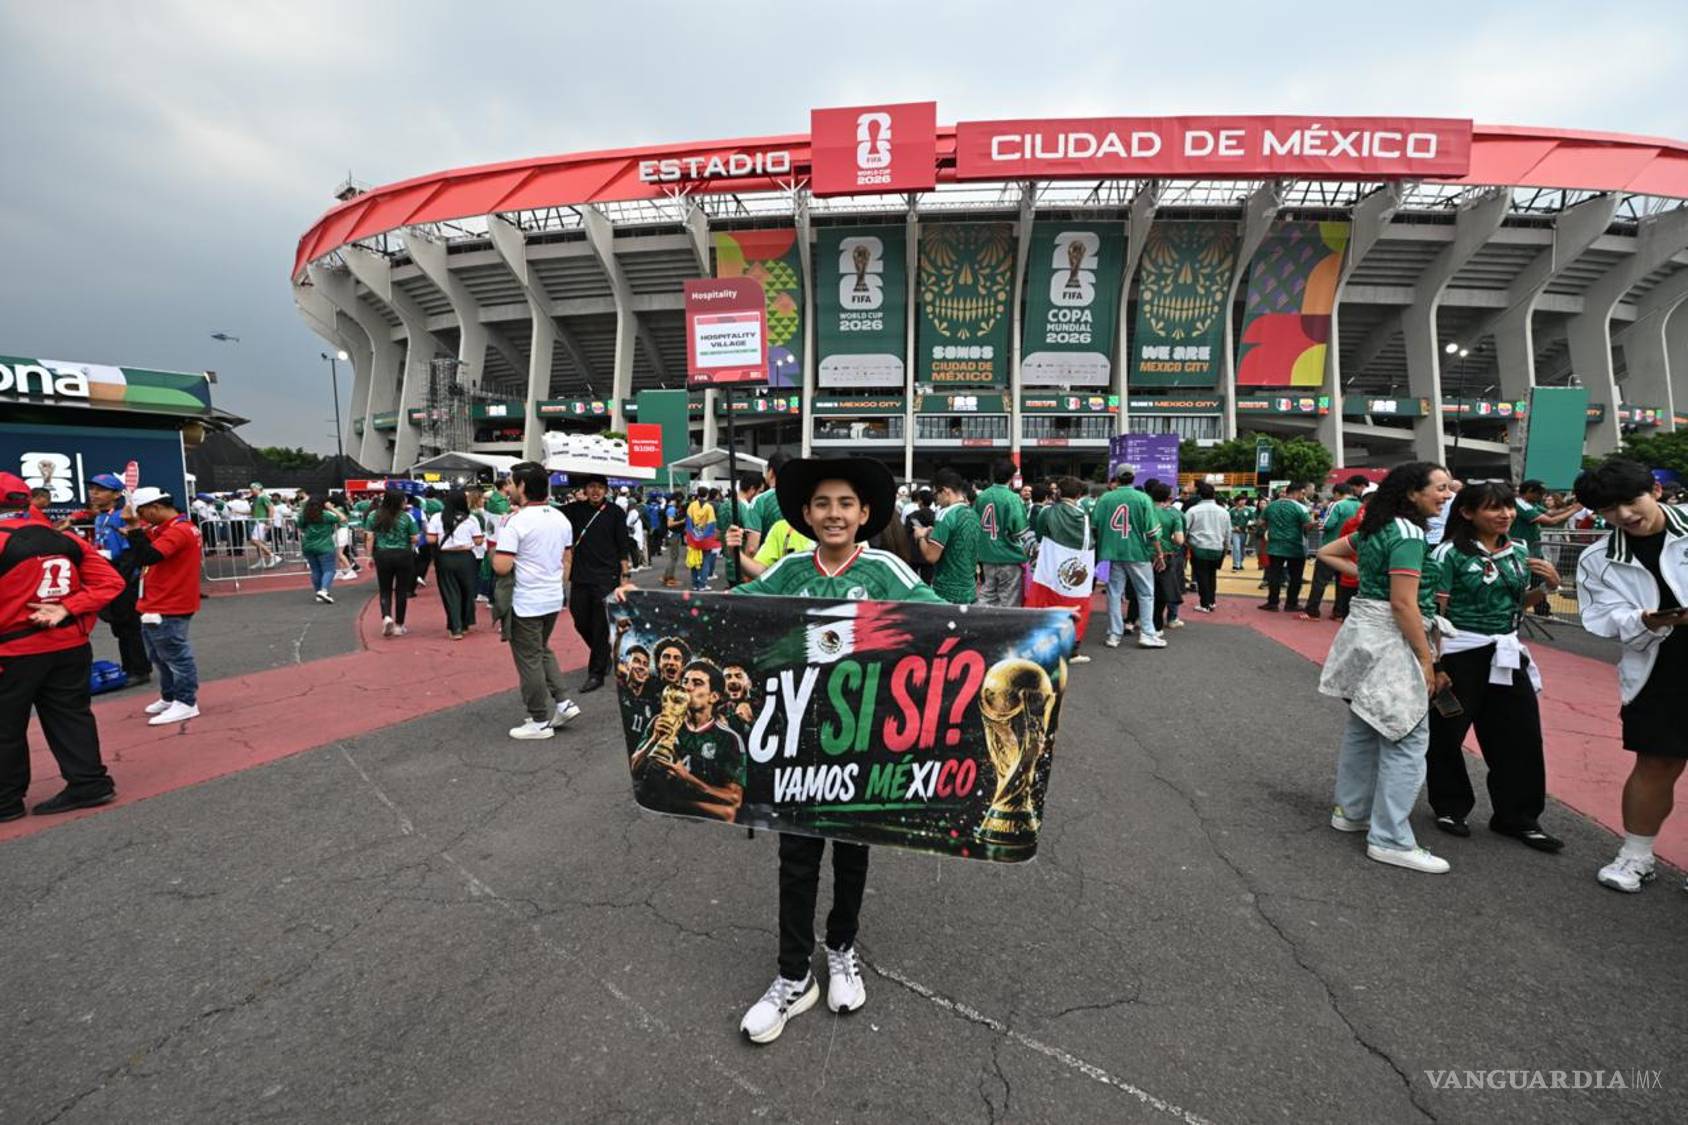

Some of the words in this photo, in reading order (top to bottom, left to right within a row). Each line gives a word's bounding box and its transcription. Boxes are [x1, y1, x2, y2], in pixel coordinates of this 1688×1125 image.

[991, 131, 1162, 161] CIUDAD
[1184, 130, 1246, 157] DE
[1262, 125, 1437, 159] MÉXICO
[639, 151, 790, 183] ESTADIO
[857, 175, 891, 185] 2026
[692, 289, 737, 300] Hospitality
[852, 295, 872, 304] FIFA
[1062, 291, 1083, 300] FIFA
[839, 312, 867, 320] WORLD
[1047, 309, 1093, 323] COPA
[839, 320, 883, 331] 2026
[1046, 323, 1093, 332] MUNDIAL
[700, 332, 756, 340] HOSPITALITY
[1045, 332, 1092, 343] 2026
[710, 340, 747, 348] VILLAGE
[932, 346, 994, 360] SOMOS
[1141, 346, 1171, 360] WE
[1172, 346, 1211, 360] ARE
[931, 362, 976, 371] CIUDAD
[978, 362, 993, 371] DE
[1140, 361, 1182, 373] MEXICO
[1184, 362, 1210, 372] CITY
[931, 371, 993, 381] MÉXICO
[980, 503, 999, 541] 4
[1110, 503, 1131, 539] 4
[748, 666, 820, 763] ¿Y
[820, 660, 882, 756] SI
[883, 637, 986, 753] SÍ?
[773, 763, 859, 803] VAMOS
[864, 754, 977, 803] MÉXICO
